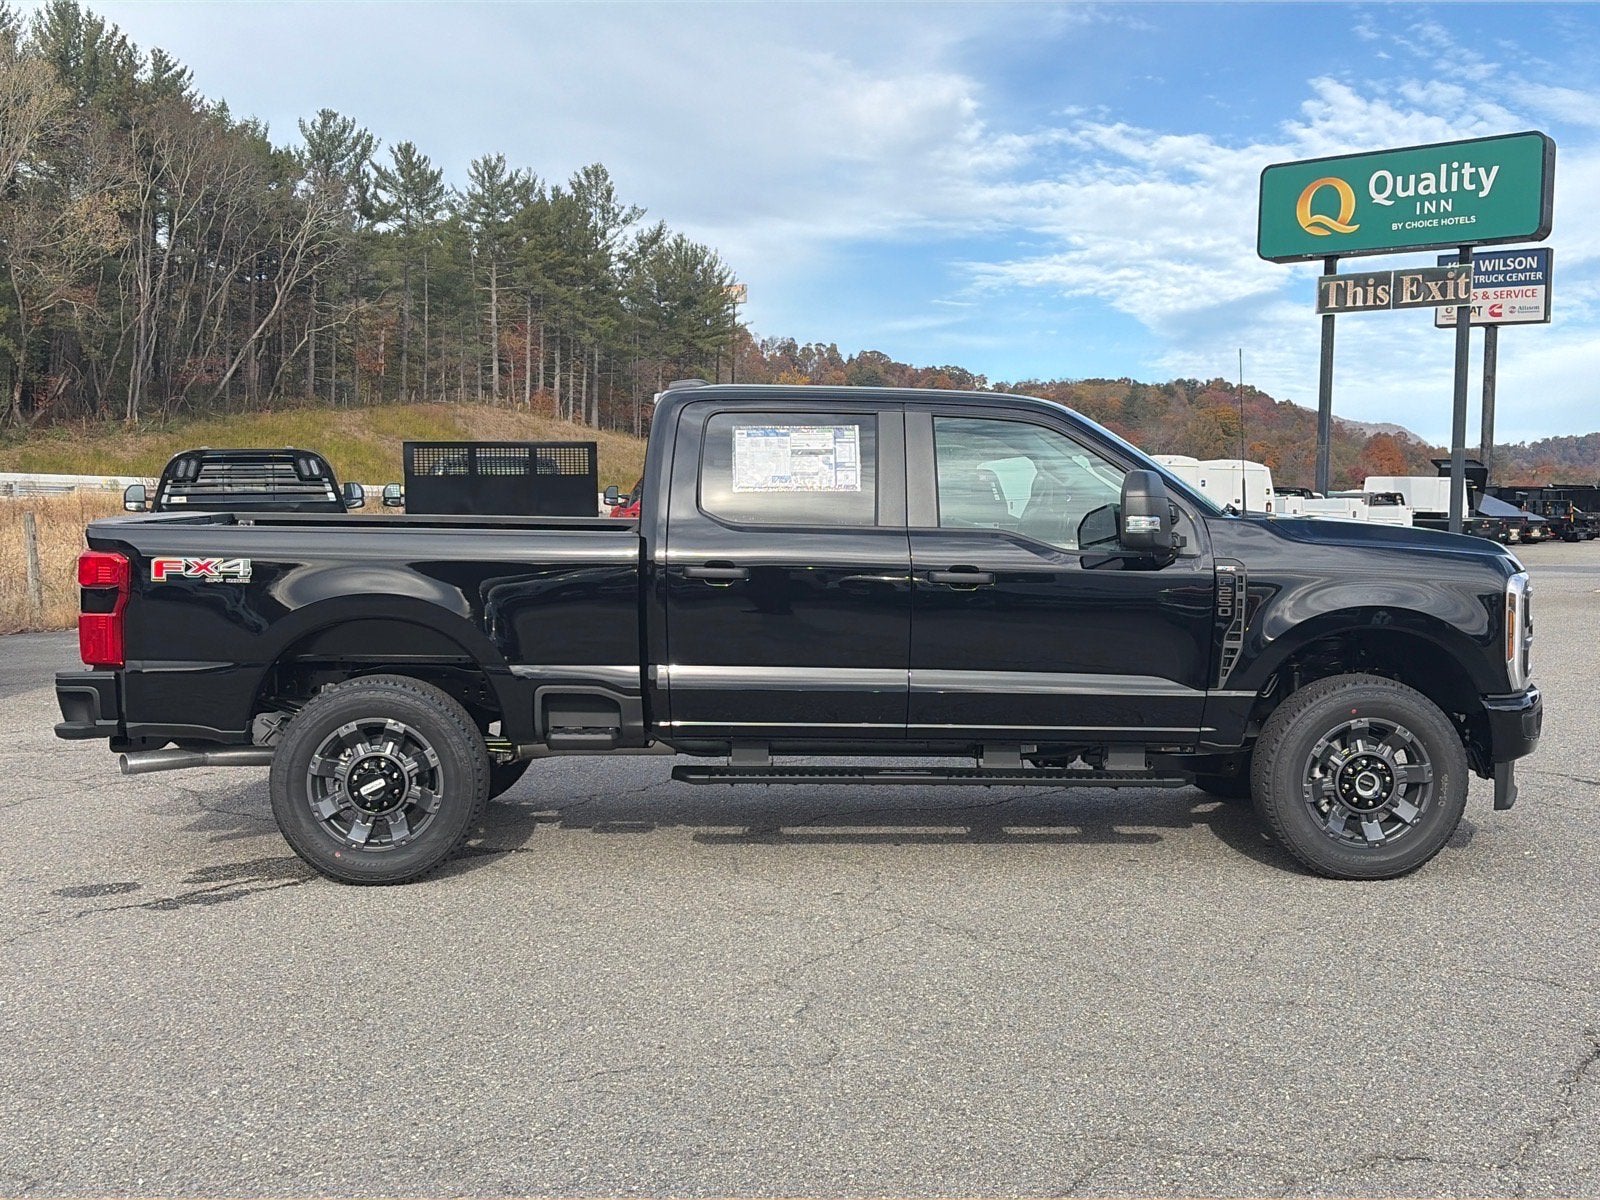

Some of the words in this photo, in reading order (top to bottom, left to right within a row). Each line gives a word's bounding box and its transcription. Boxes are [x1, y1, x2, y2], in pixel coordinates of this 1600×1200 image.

[1368, 161, 1500, 206] Quality
[1296, 176, 1360, 236] Q
[1416, 198, 1453, 215] INN
[1391, 222, 1404, 231] BY
[1405, 219, 1439, 229] CHOICE
[1441, 215, 1476, 226] HOTELS
[1480, 256, 1538, 271] WILSON
[1474, 273, 1504, 283] TRUCK
[1506, 272, 1543, 281] CENTER
[1321, 278, 1390, 309] This
[1400, 271, 1470, 304] Exit
[1481, 290, 1490, 300] &
[1493, 288, 1538, 299] SERVICE
[151, 557, 252, 582] FX4
